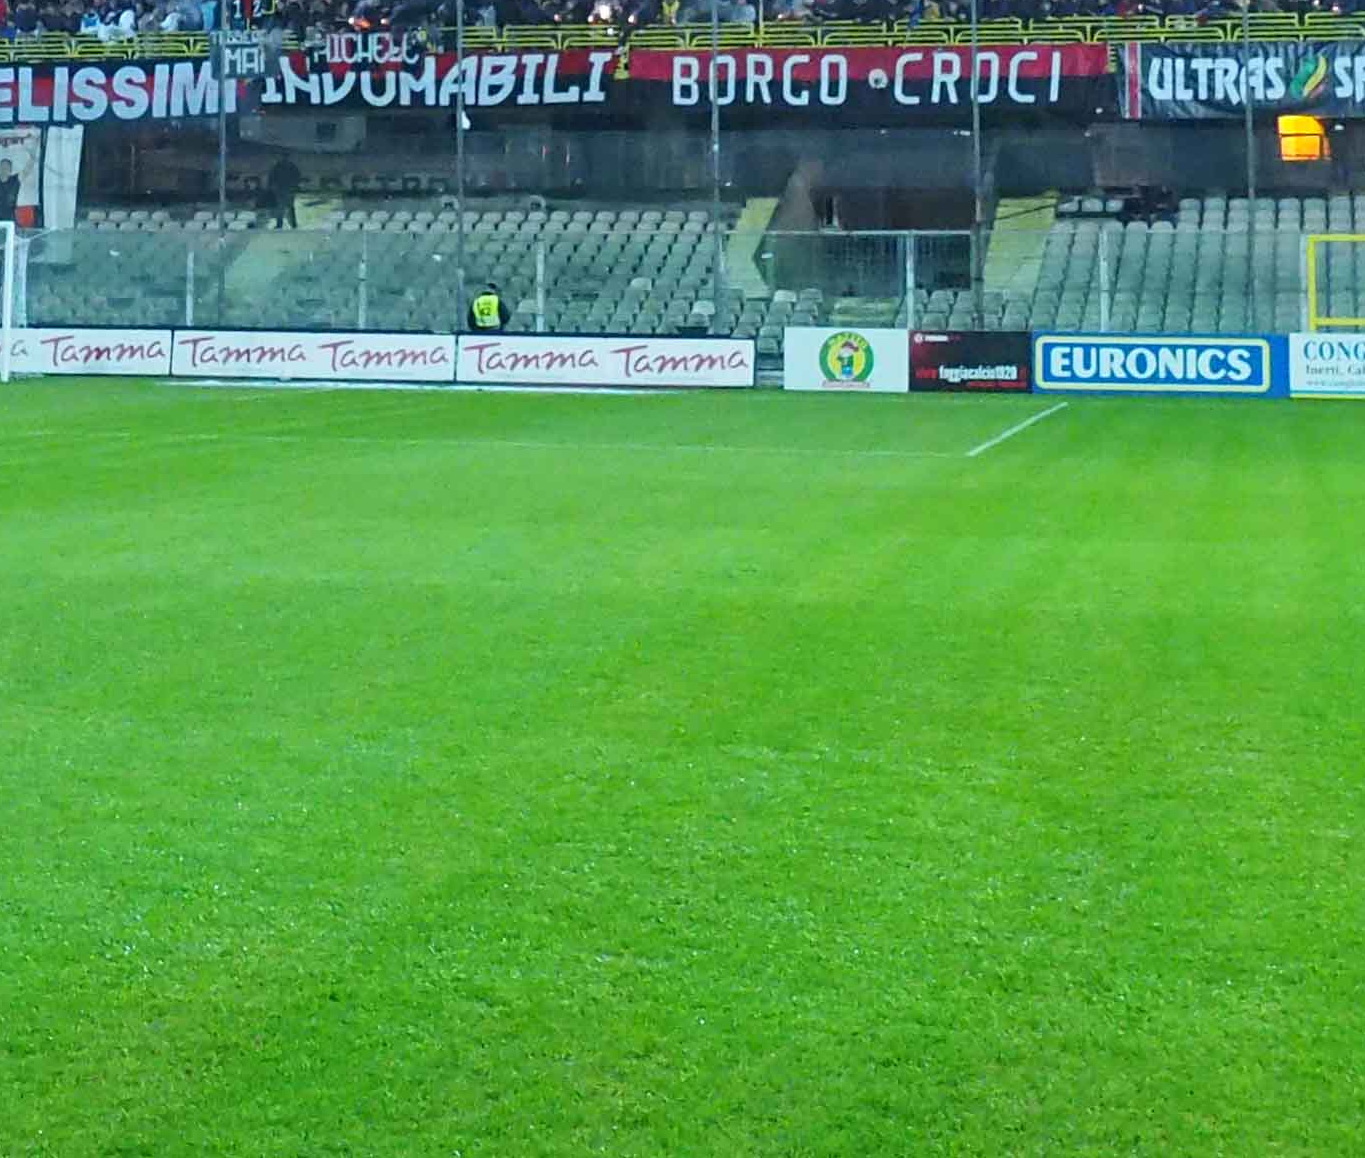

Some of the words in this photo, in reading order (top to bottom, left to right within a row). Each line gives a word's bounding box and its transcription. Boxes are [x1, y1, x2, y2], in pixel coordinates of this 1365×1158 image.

[1147, 55, 1286, 101] ULTRAS
[40, 334, 165, 364] Tamma
[178, 336, 307, 366] Tamma
[319, 339, 449, 371] Tamma
[463, 342, 599, 374] Tamma
[611, 344, 749, 378] Tamma
[1050, 345, 1252, 381] EURONICS
